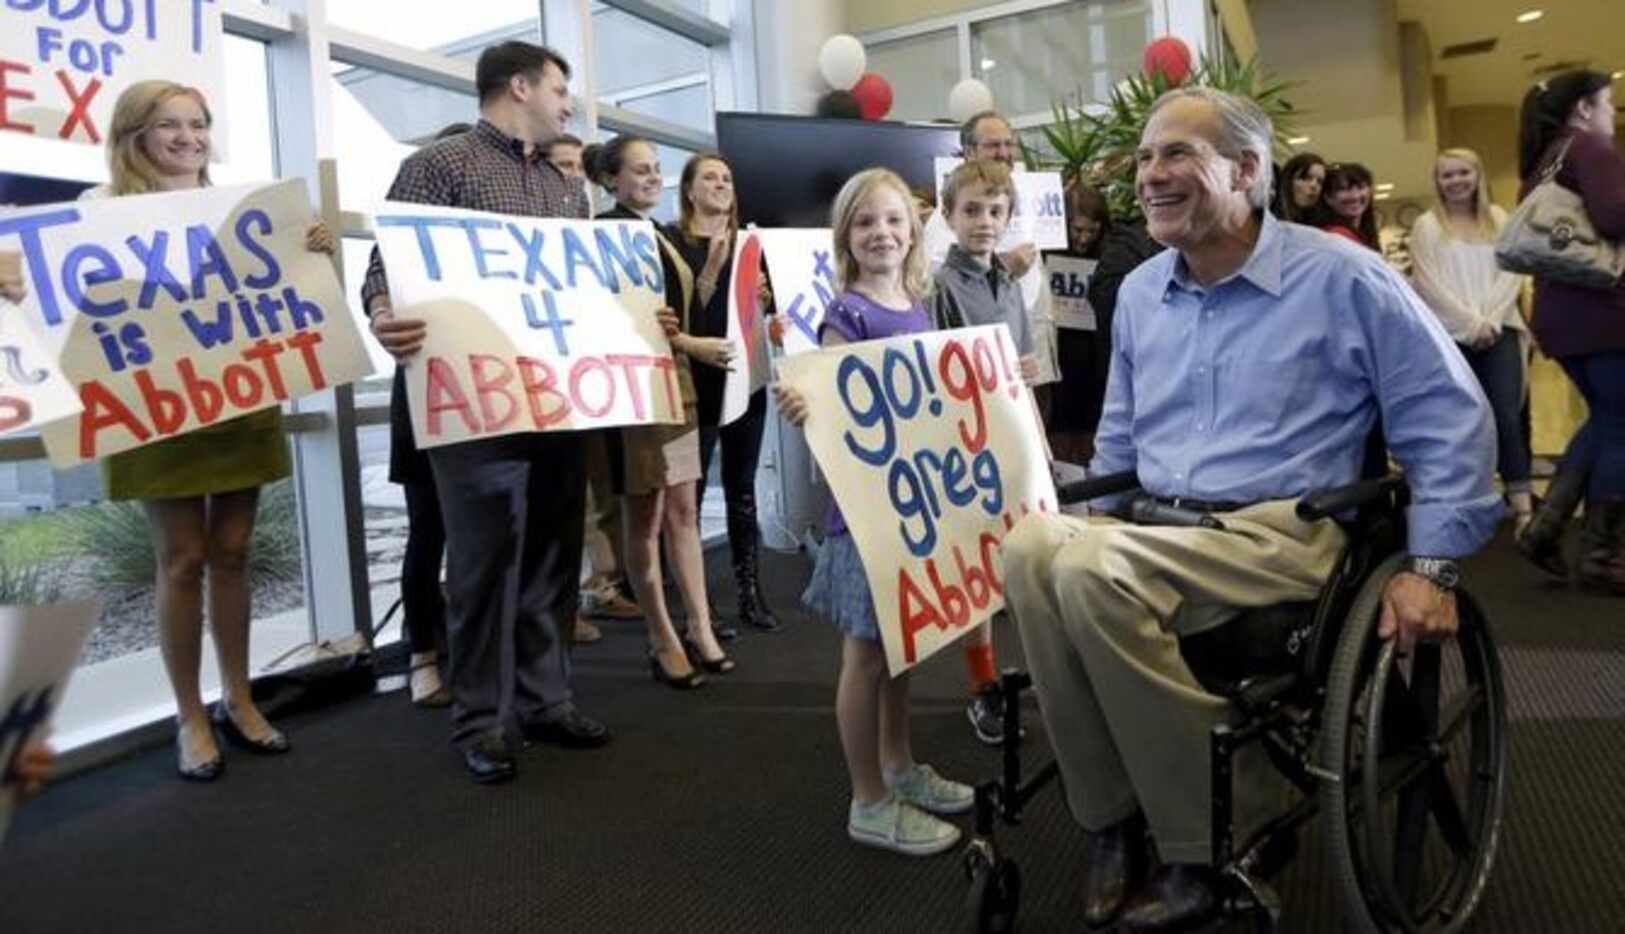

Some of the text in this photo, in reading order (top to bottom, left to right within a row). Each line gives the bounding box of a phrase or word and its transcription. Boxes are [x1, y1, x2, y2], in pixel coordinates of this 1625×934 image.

[375, 214, 666, 294] TEXANS
[90, 321, 153, 373] is
[181, 287, 324, 349] with
[520, 289, 574, 357] 4
[425, 353, 685, 436] ABBOTT
[837, 329, 1020, 466] go! go!
[887, 447, 1004, 558] greg
